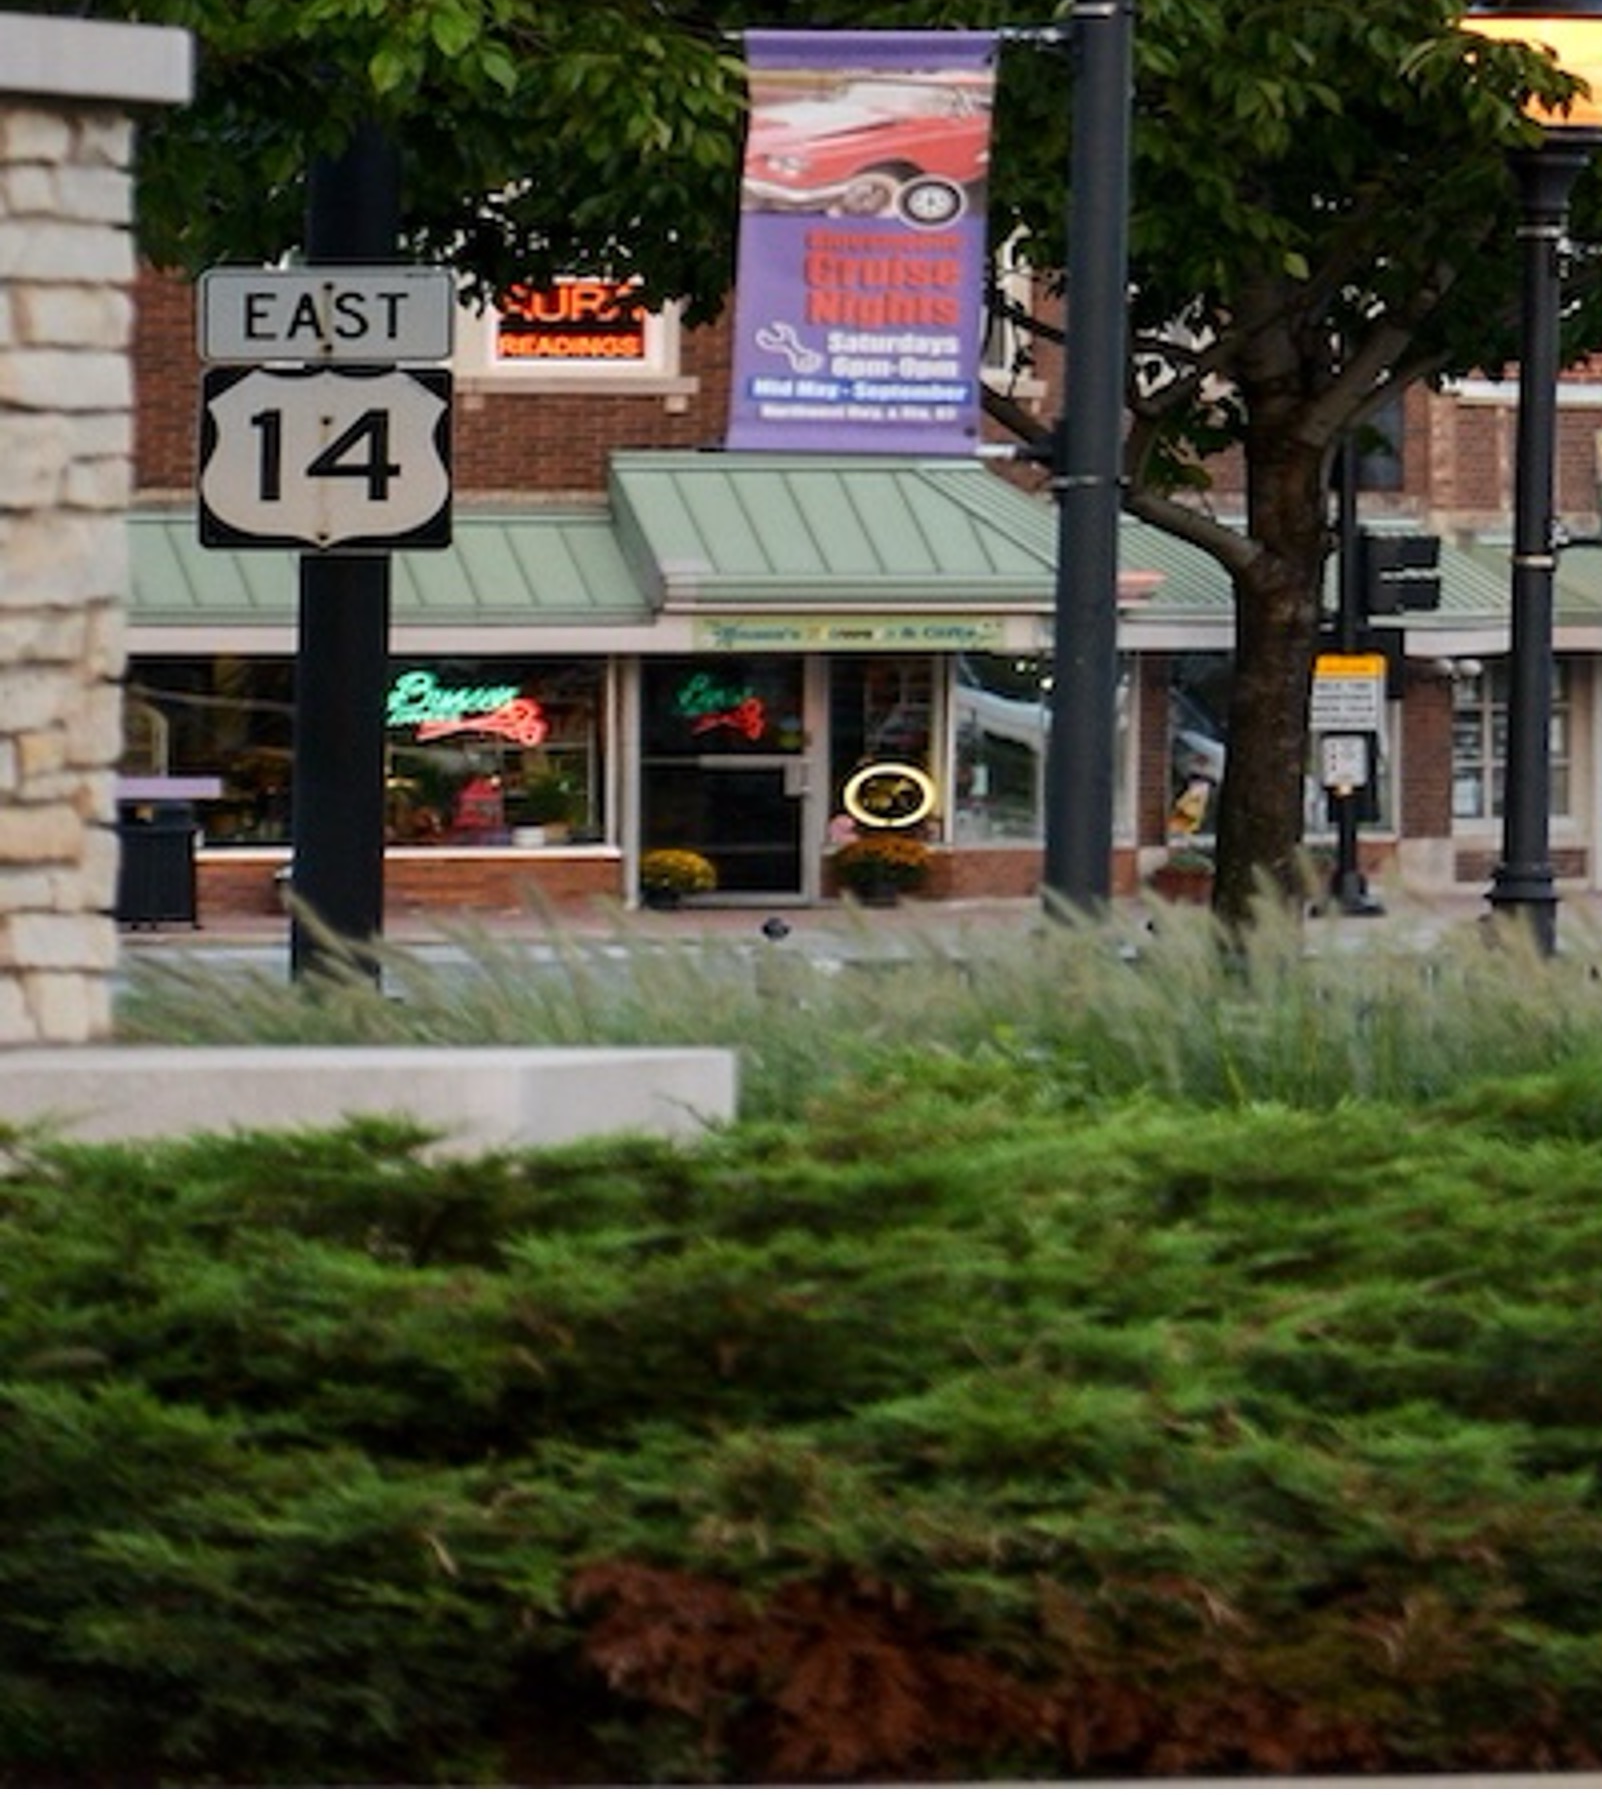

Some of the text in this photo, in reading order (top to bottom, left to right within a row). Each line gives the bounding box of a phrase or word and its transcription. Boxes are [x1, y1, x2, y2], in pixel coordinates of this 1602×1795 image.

[806, 252, 959, 287] Cruise
[244, 293, 408, 340] EAST
[807, 290, 959, 329] Nights
[827, 332, 959, 356] Saturdays
[251, 409, 401, 501] 14
